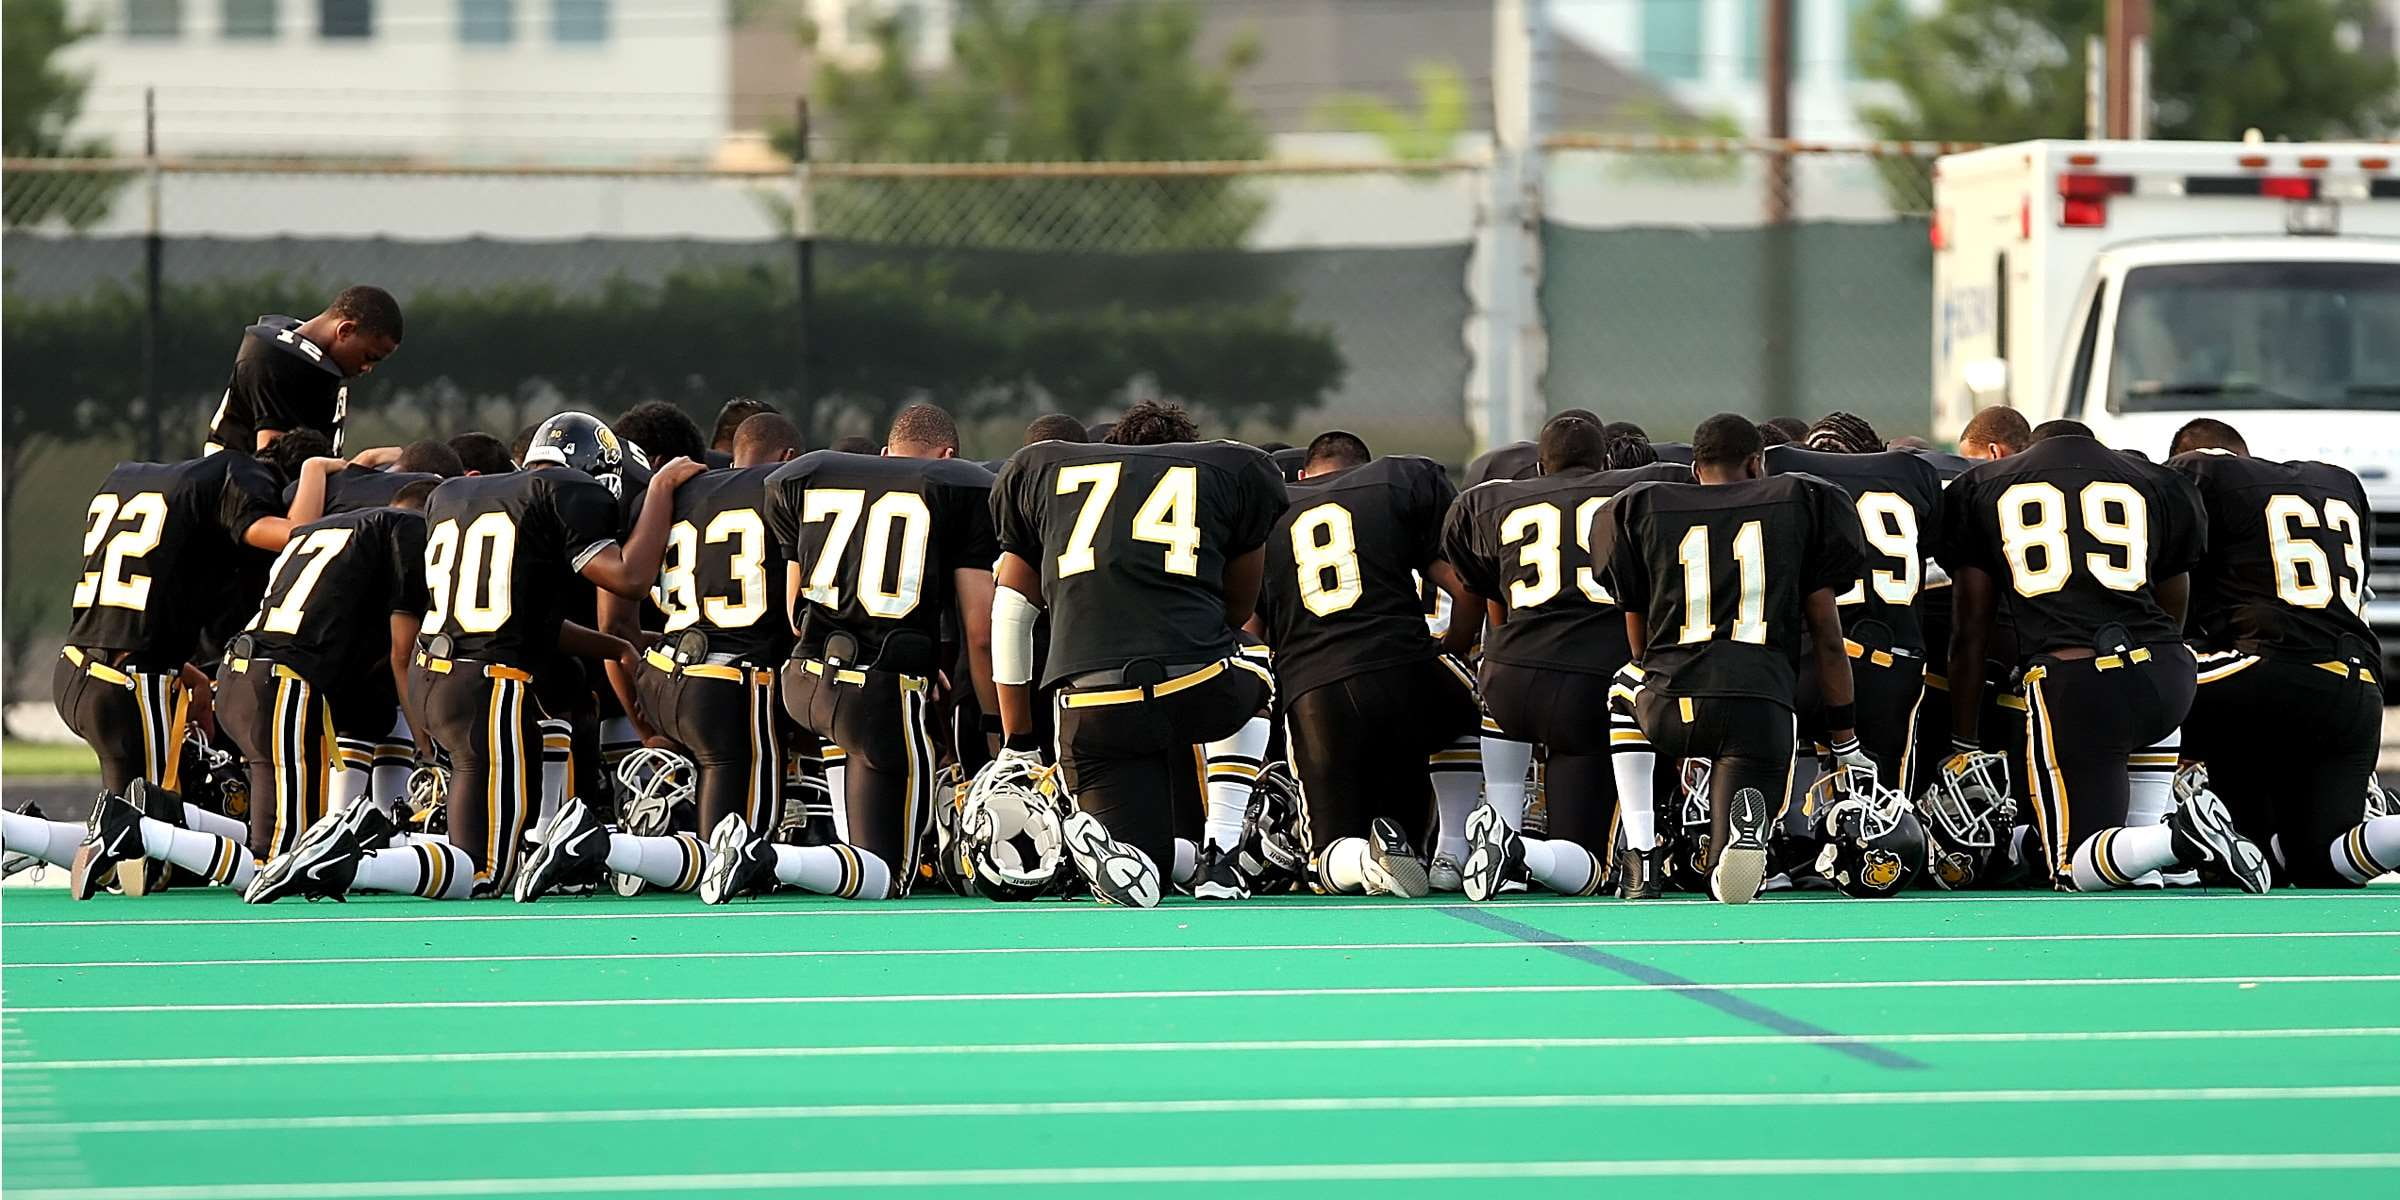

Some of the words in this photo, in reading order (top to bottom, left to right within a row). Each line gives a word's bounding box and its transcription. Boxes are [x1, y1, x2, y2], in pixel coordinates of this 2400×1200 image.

[276, 328, 323, 362] 12
[72, 491, 168, 611] 22
[801, 488, 931, 619] 70
[1056, 461, 1200, 579] 74
[1290, 502, 1363, 618] 8
[1835, 491, 1920, 606] 9
[1997, 480, 2148, 598] 89
[2265, 494, 2367, 620] 63
[244, 528, 353, 635] 7
[1677, 520, 1767, 645] 11
